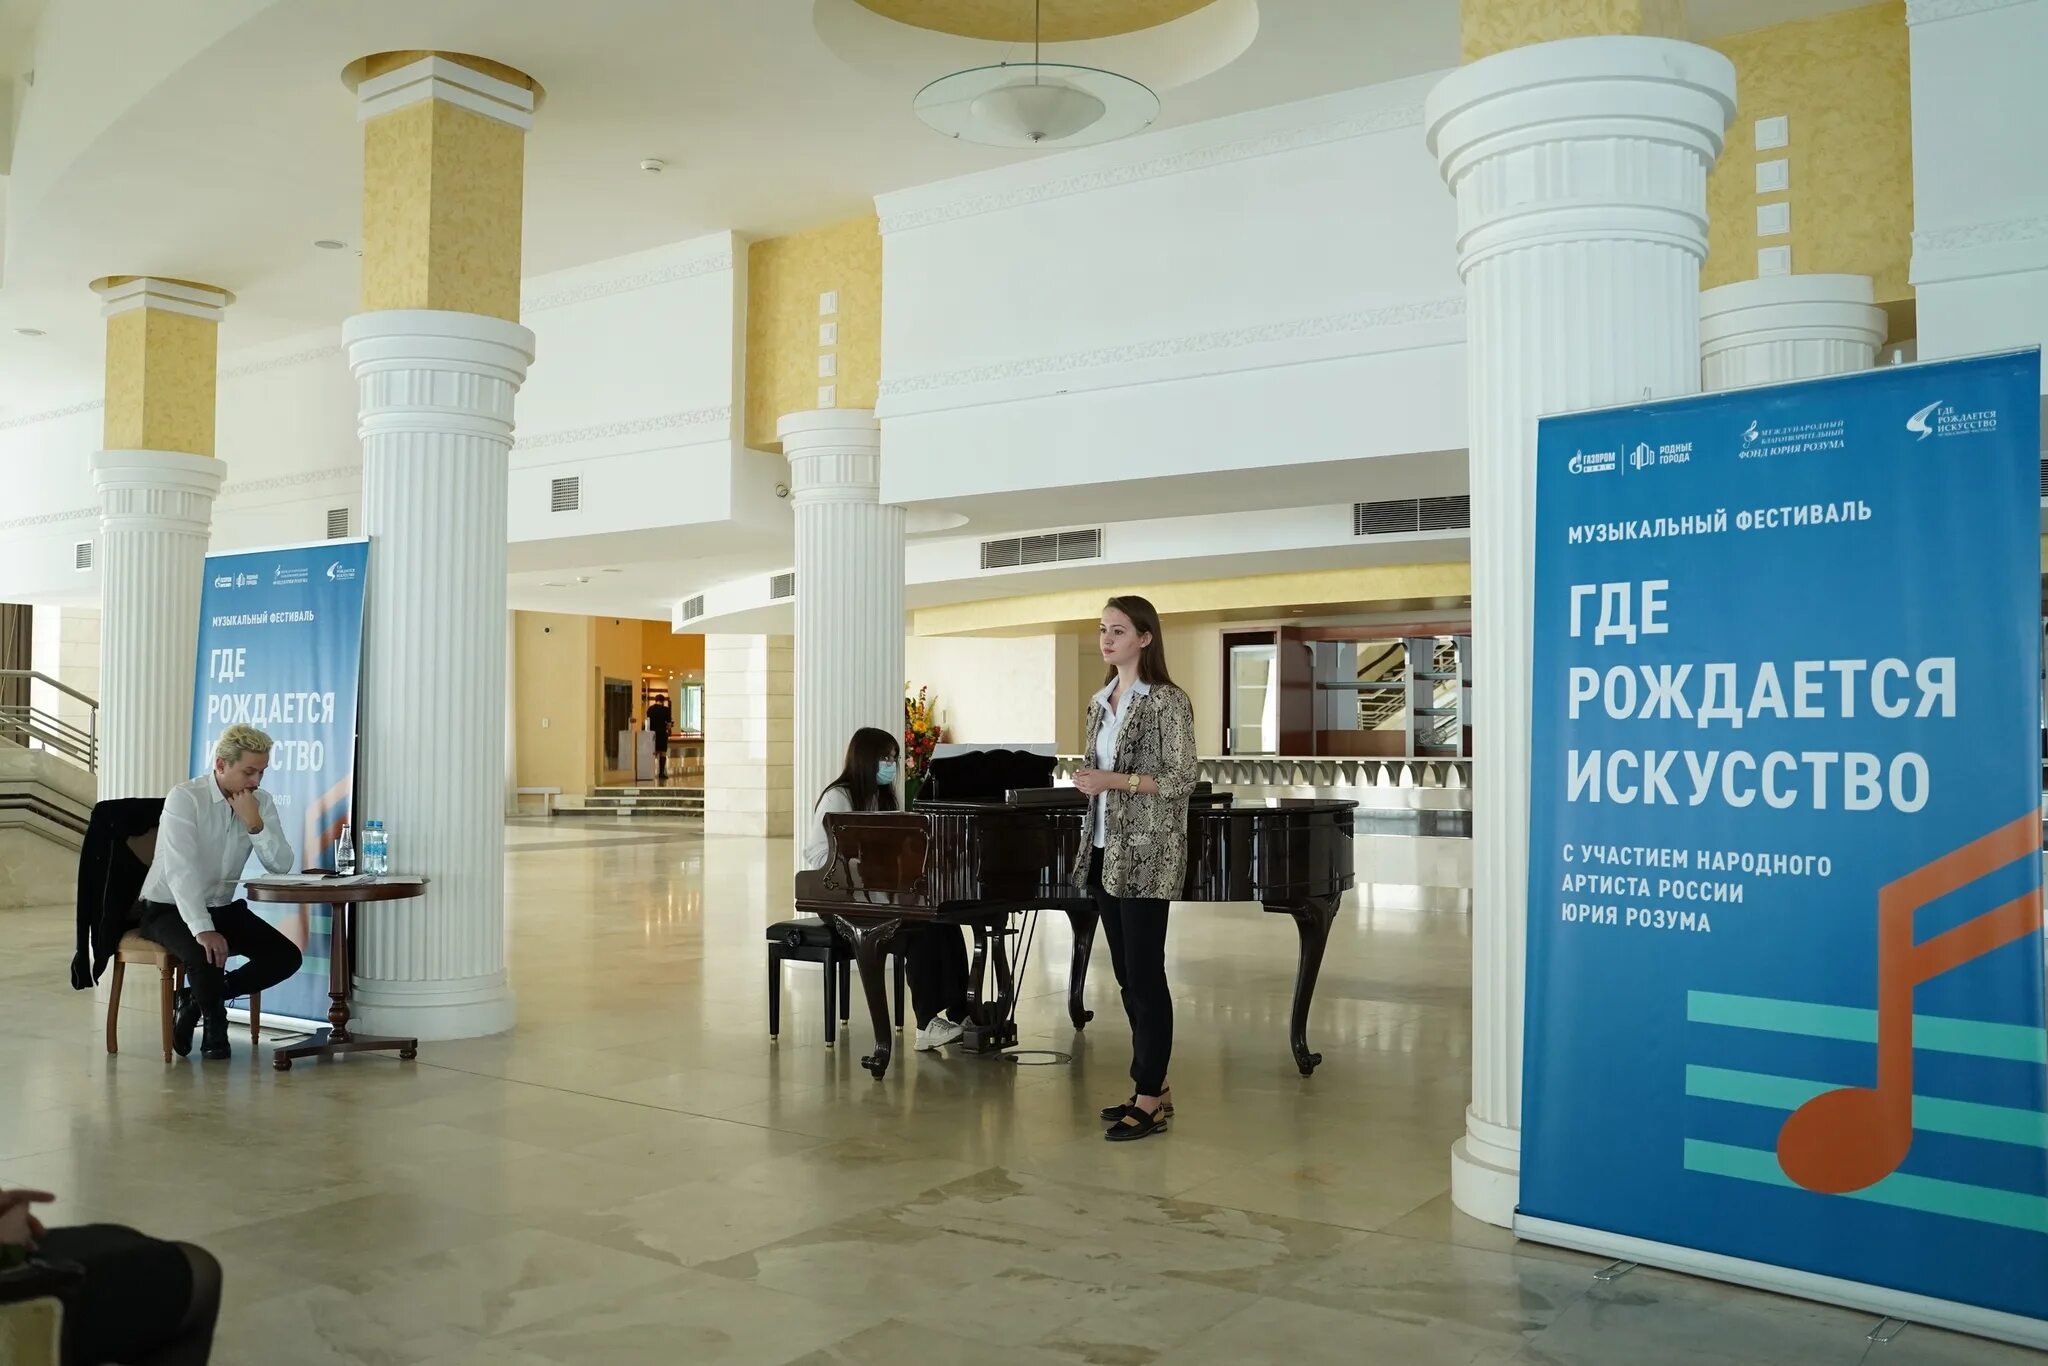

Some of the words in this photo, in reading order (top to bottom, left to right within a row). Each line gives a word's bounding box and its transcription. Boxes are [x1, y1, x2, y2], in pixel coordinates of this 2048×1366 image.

[1938, 407, 1954, 415] ГДЕ
[1938, 411, 1996, 424] РОЖДАЕТСЯ
[1938, 420, 1997, 433] ИСКУССТВО
[1583, 452, 1616, 465] ГАЗПРОМ
[1660, 442, 1692, 454] РОДНЫЕ
[1660, 453, 1690, 465] ГОРОДА
[1739, 447, 1768, 459] ФОНД
[1770, 444, 1801, 456] ЮРИЯ
[1803, 439, 1845, 452] РОЗУМА
[1568, 508, 1727, 544] МУЗЫКАЛЬНЫЙ
[1736, 500, 1872, 531] ФЕСТИВАЛЬ
[212, 611, 268, 627] МУЗЫКАЛЬНЫЙ
[269, 610, 315, 624] ФЕСТИВАЛЬ
[1570, 579, 1669, 646] ГДЕ
[210, 648, 246, 683] ГДЕ
[1568, 657, 1956, 729] РОЖДАЕТСЯ
[207, 692, 335, 728] РОЖДАЕТСЯ
[204, 740, 324, 771] ИСТВО
[1567, 749, 1930, 813] ИСКУССТВО
[1563, 844, 1574, 863] С
[1581, 844, 1688, 868] УЧАСТИЕМ
[1697, 850, 1832, 877] НАРОДНОГО
[1562, 873, 1650, 897] АРТИСТА
[1659, 879, 1743, 904] РОССИИ
[1561, 902, 1618, 925] ЮРИЯ
[1626, 907, 1711, 932] РОЗУМА
